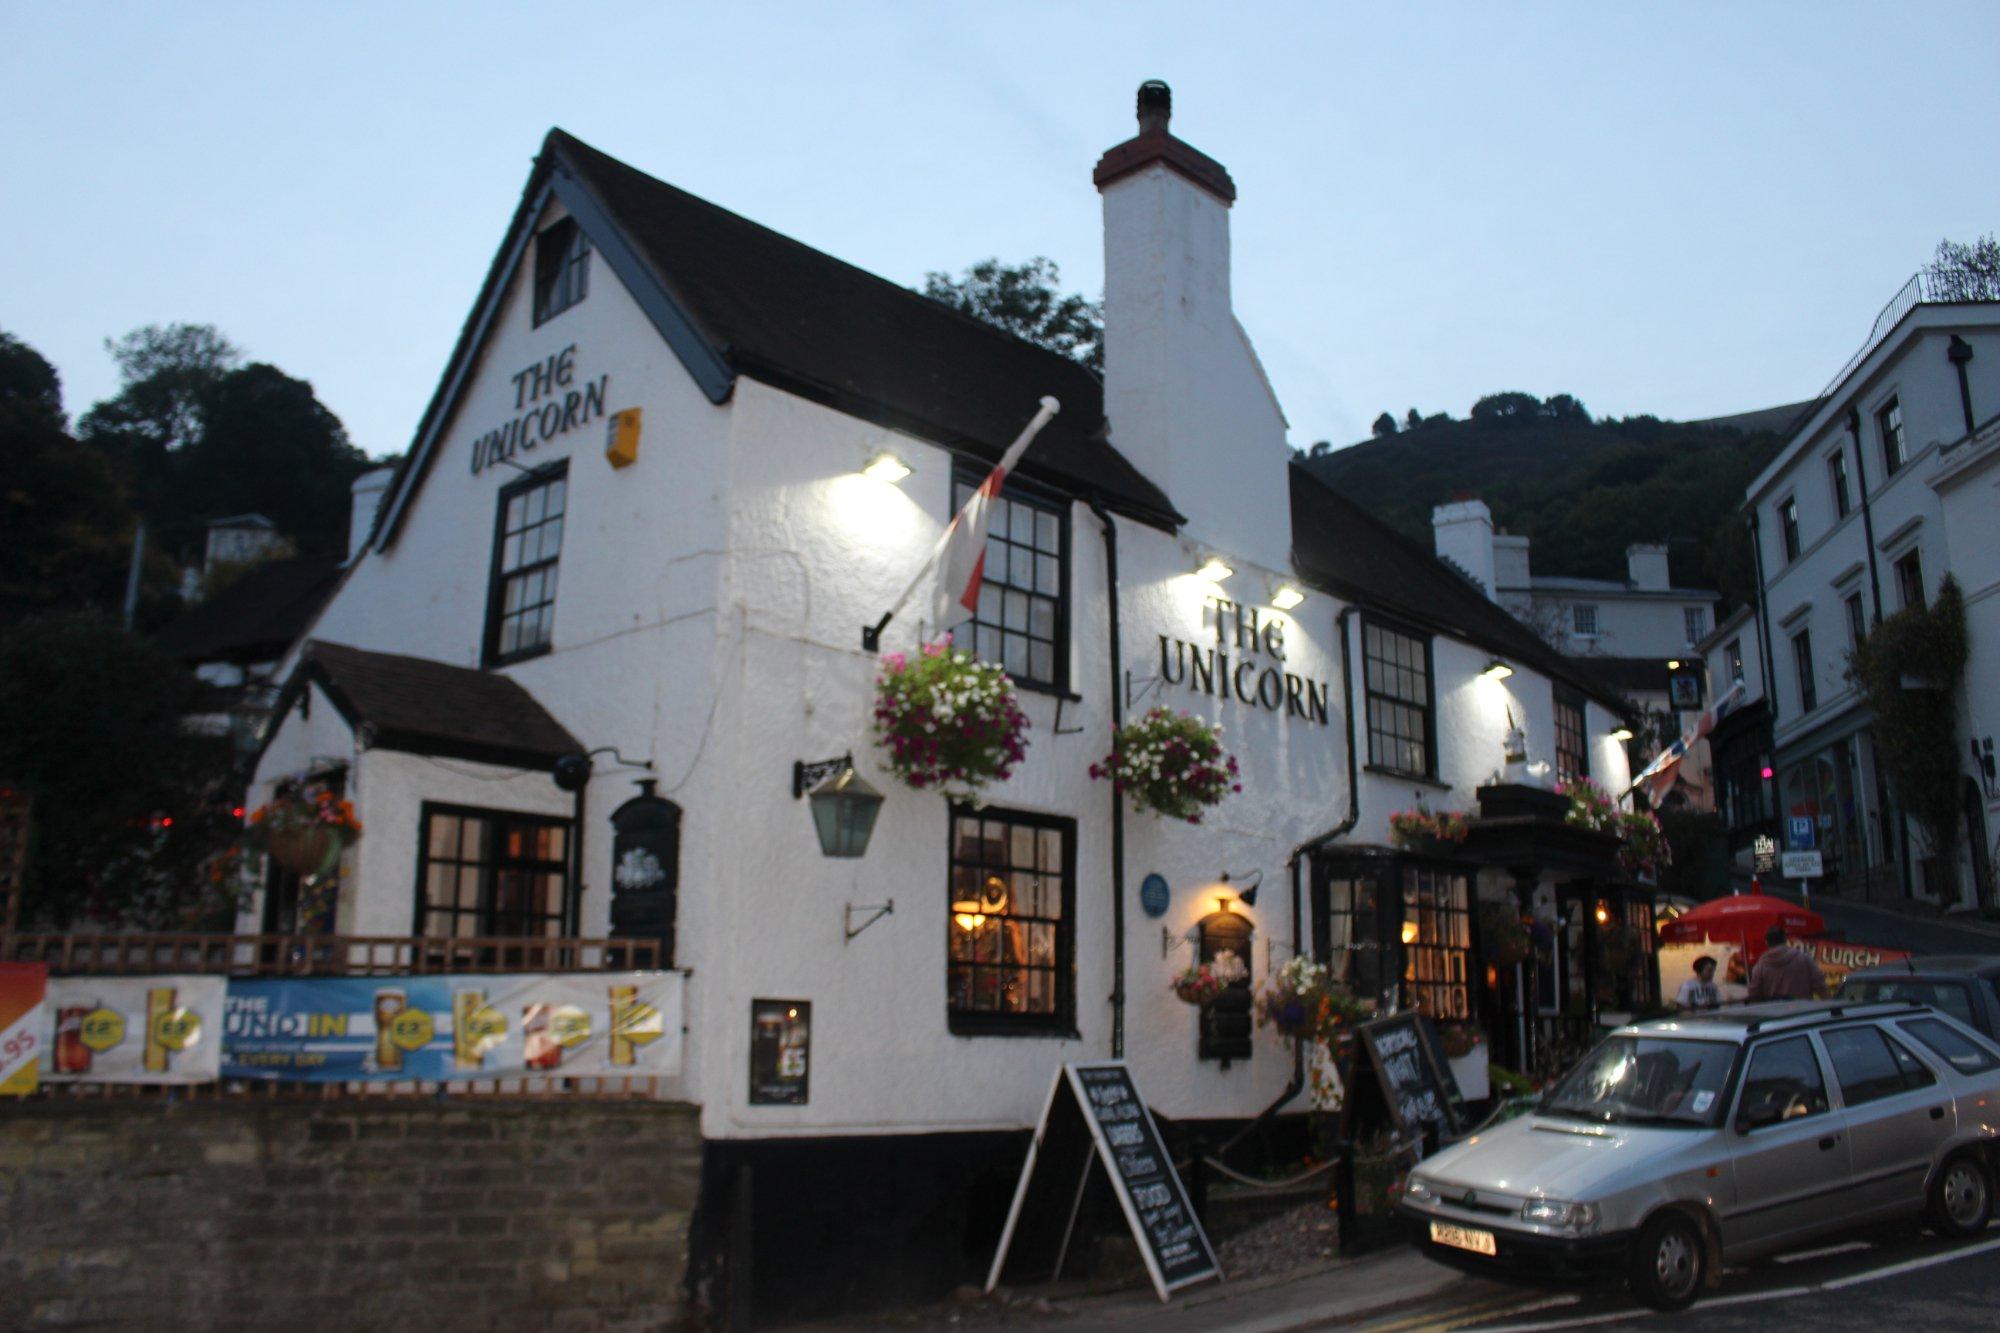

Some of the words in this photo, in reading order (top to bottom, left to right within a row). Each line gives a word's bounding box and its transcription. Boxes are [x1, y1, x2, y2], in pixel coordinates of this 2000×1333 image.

[511, 342, 577, 410] THE
[470, 373, 608, 476] UNICORN
[1206, 595, 1287, 662] THE
[1158, 634, 1329, 725] UNICORN
[1822, 943, 1881, 969] LUNCH
[223, 995, 268, 1012] THE
[307, 1012, 349, 1038] IN
